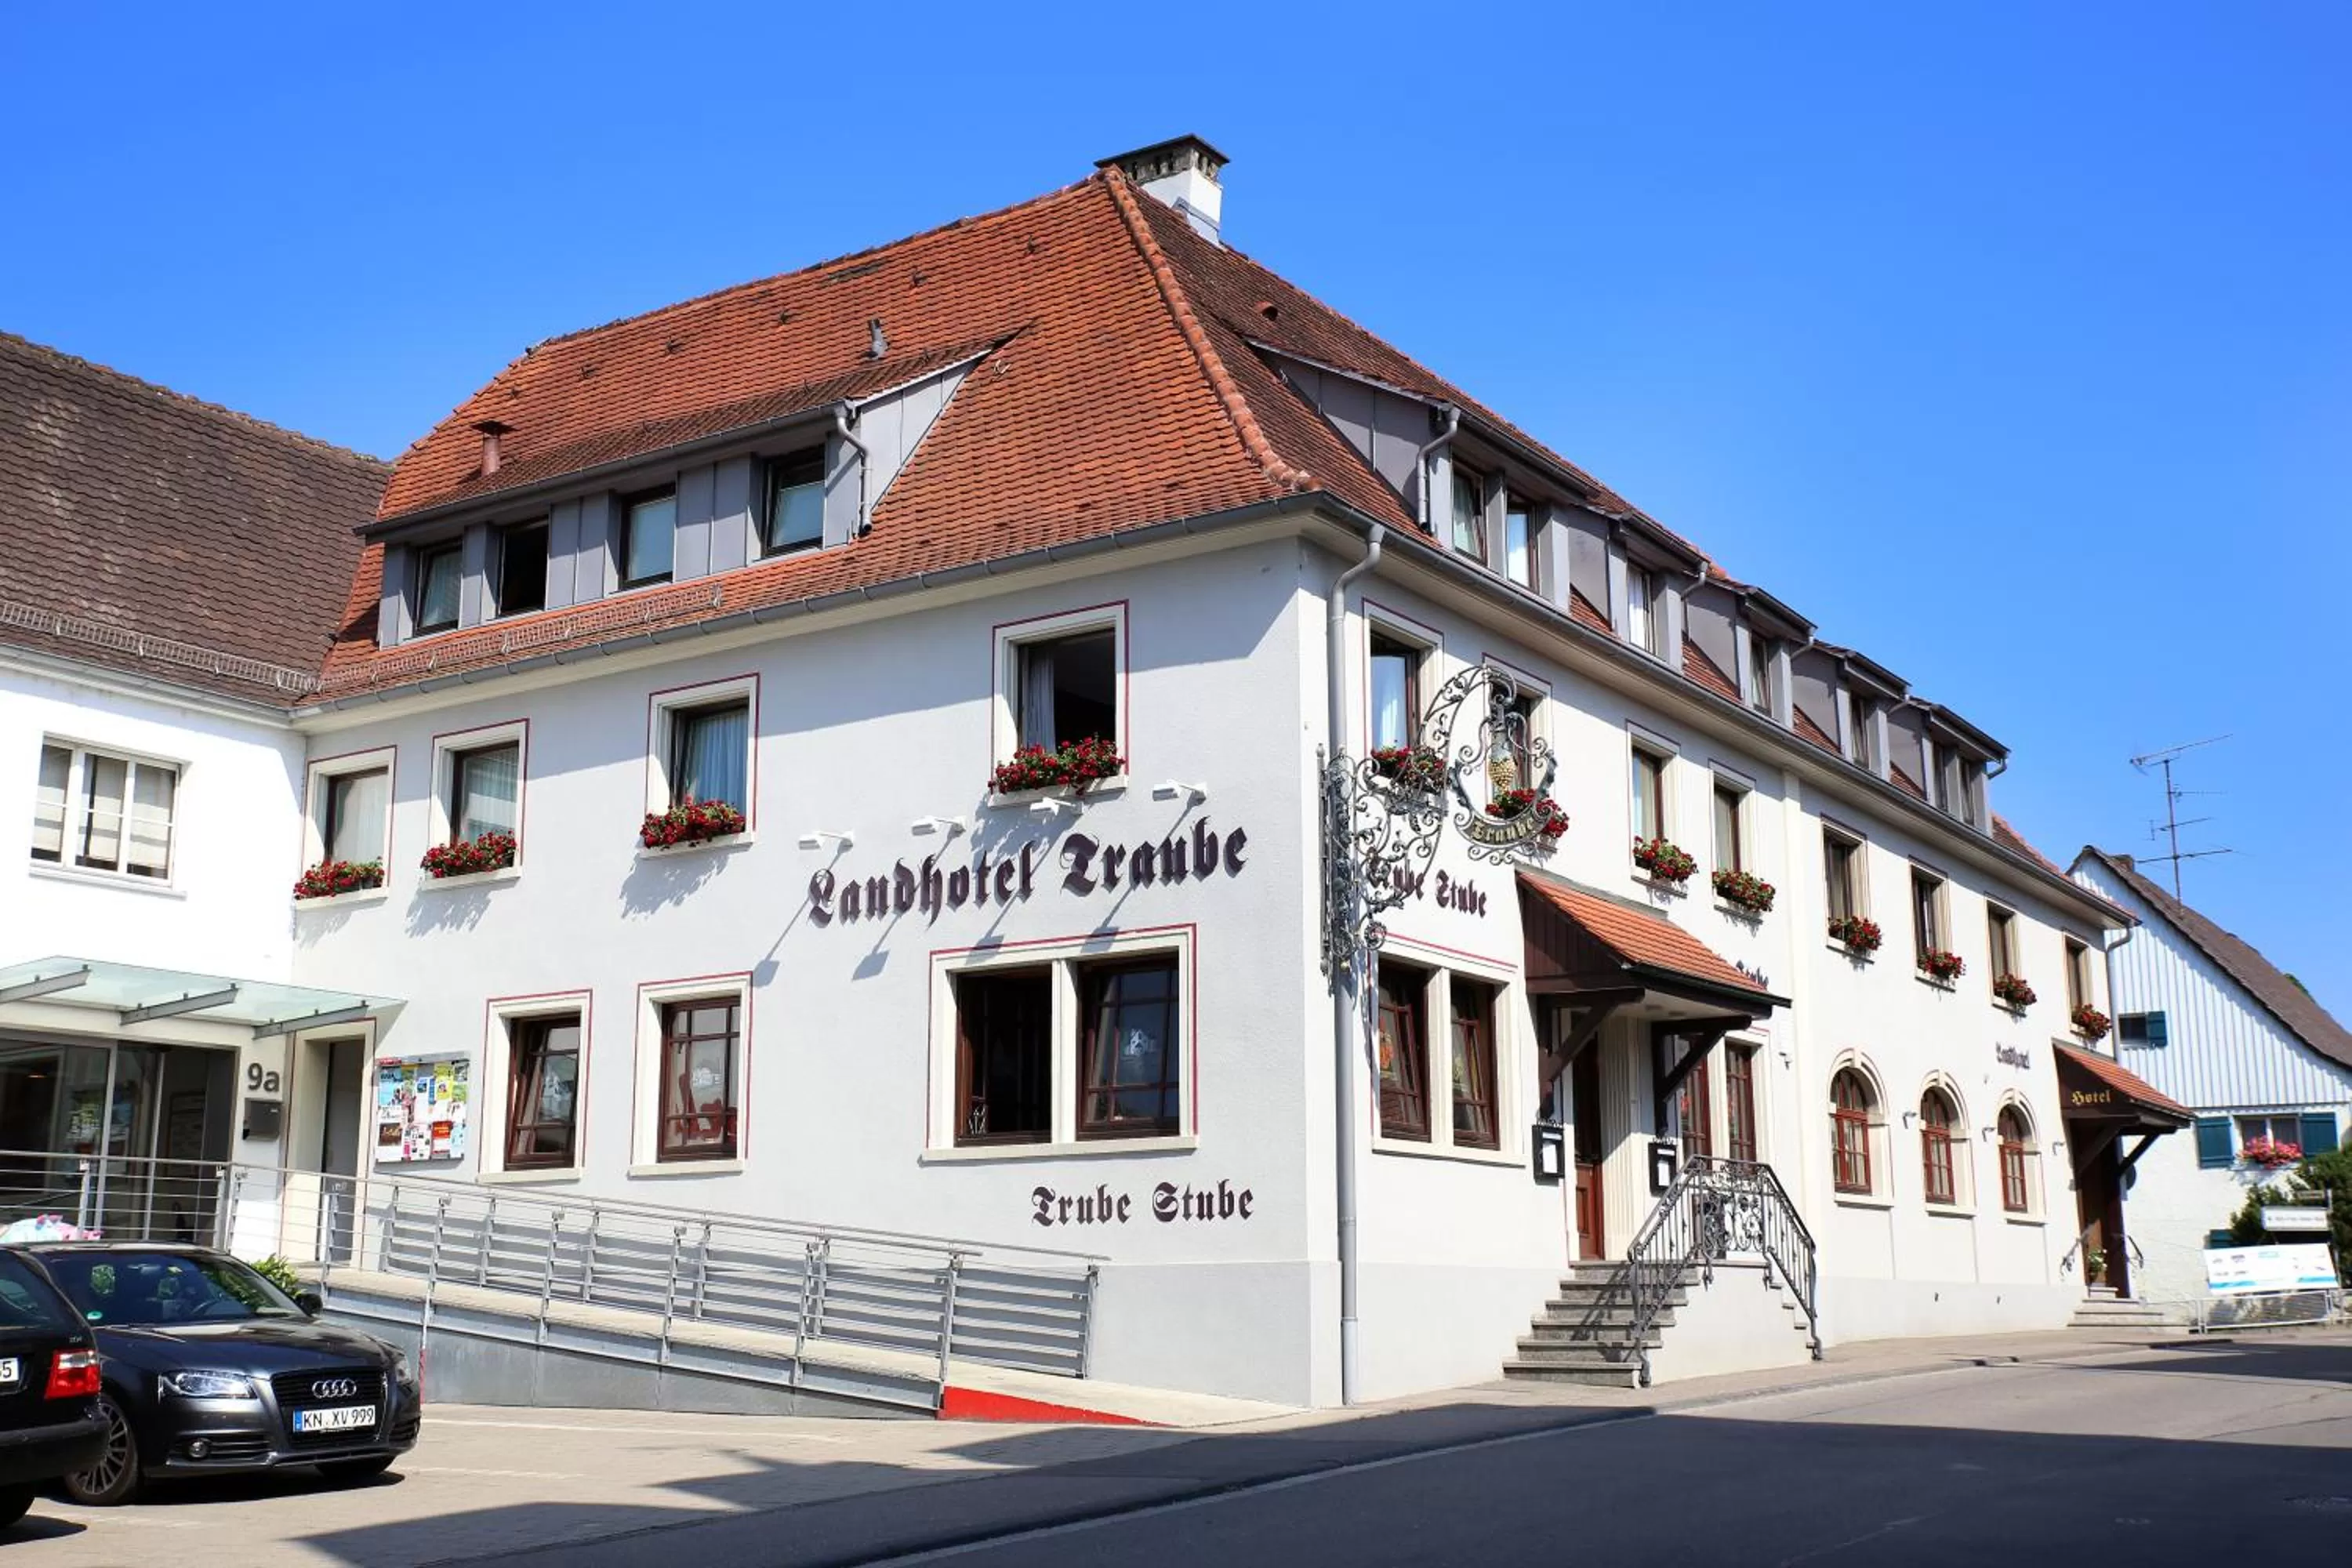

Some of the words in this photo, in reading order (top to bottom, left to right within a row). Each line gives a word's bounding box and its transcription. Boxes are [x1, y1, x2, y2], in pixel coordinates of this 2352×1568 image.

[1472, 817, 1534, 840] Traube
[808, 840, 1035, 930] Landhotel
[1059, 815, 1248, 897] Traube
[1436, 869, 1486, 918] Stube
[248, 1062, 280, 1091] 9a
[2071, 1091, 2111, 1105] Hotel
[1032, 1183, 1131, 1226] Trube
[1152, 1178, 1254, 1222] Stube
[0, 1360, 12, 1378] 5
[303, 1412, 322, 1428] KN
[332, 1410, 348, 1426] XV
[351, 1408, 374, 1424] 999
